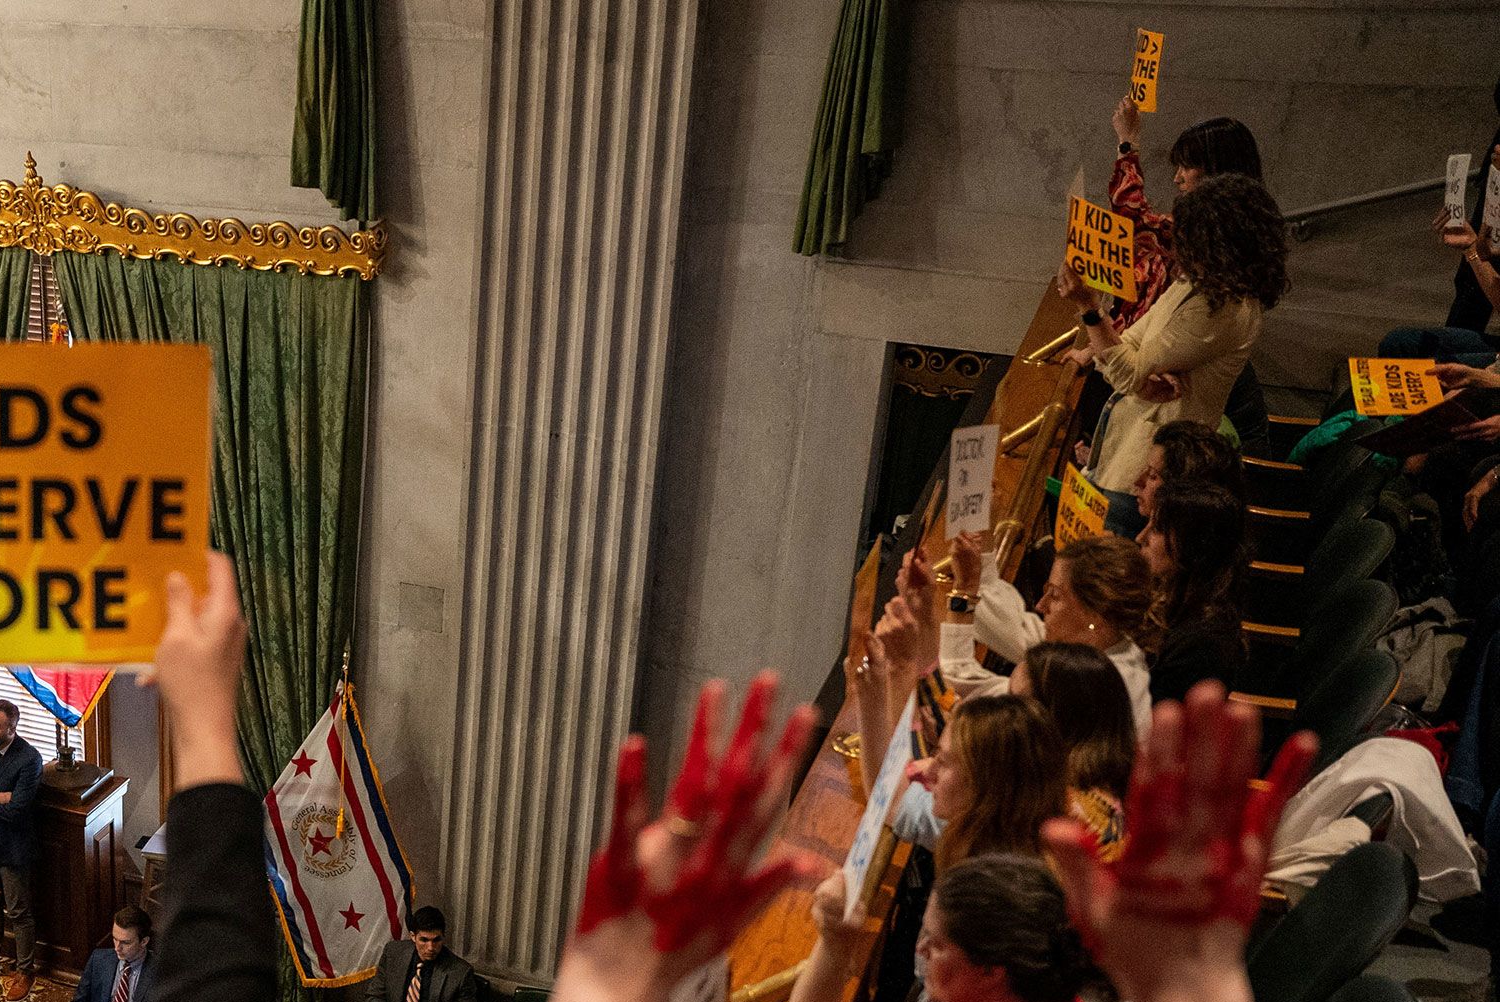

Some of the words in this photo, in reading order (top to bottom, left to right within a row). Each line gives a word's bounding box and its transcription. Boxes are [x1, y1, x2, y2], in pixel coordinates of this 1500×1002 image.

[1135, 58, 1157, 80] THE
[1128, 81, 1147, 102] NS
[1074, 199, 1079, 221] 1
[1085, 204, 1112, 234] KID
[1067, 226, 1094, 255] ALL
[1098, 238, 1131, 269] THE
[1072, 255, 1124, 290] GUNS
[1384, 365, 1403, 389] KIDS
[1404, 371, 1428, 405] SAFER?
[1388, 391, 1408, 410] ARE
[291, 802, 318, 831] General
[348, 848, 358, 862] of
[304, 862, 354, 878] Tennessee
